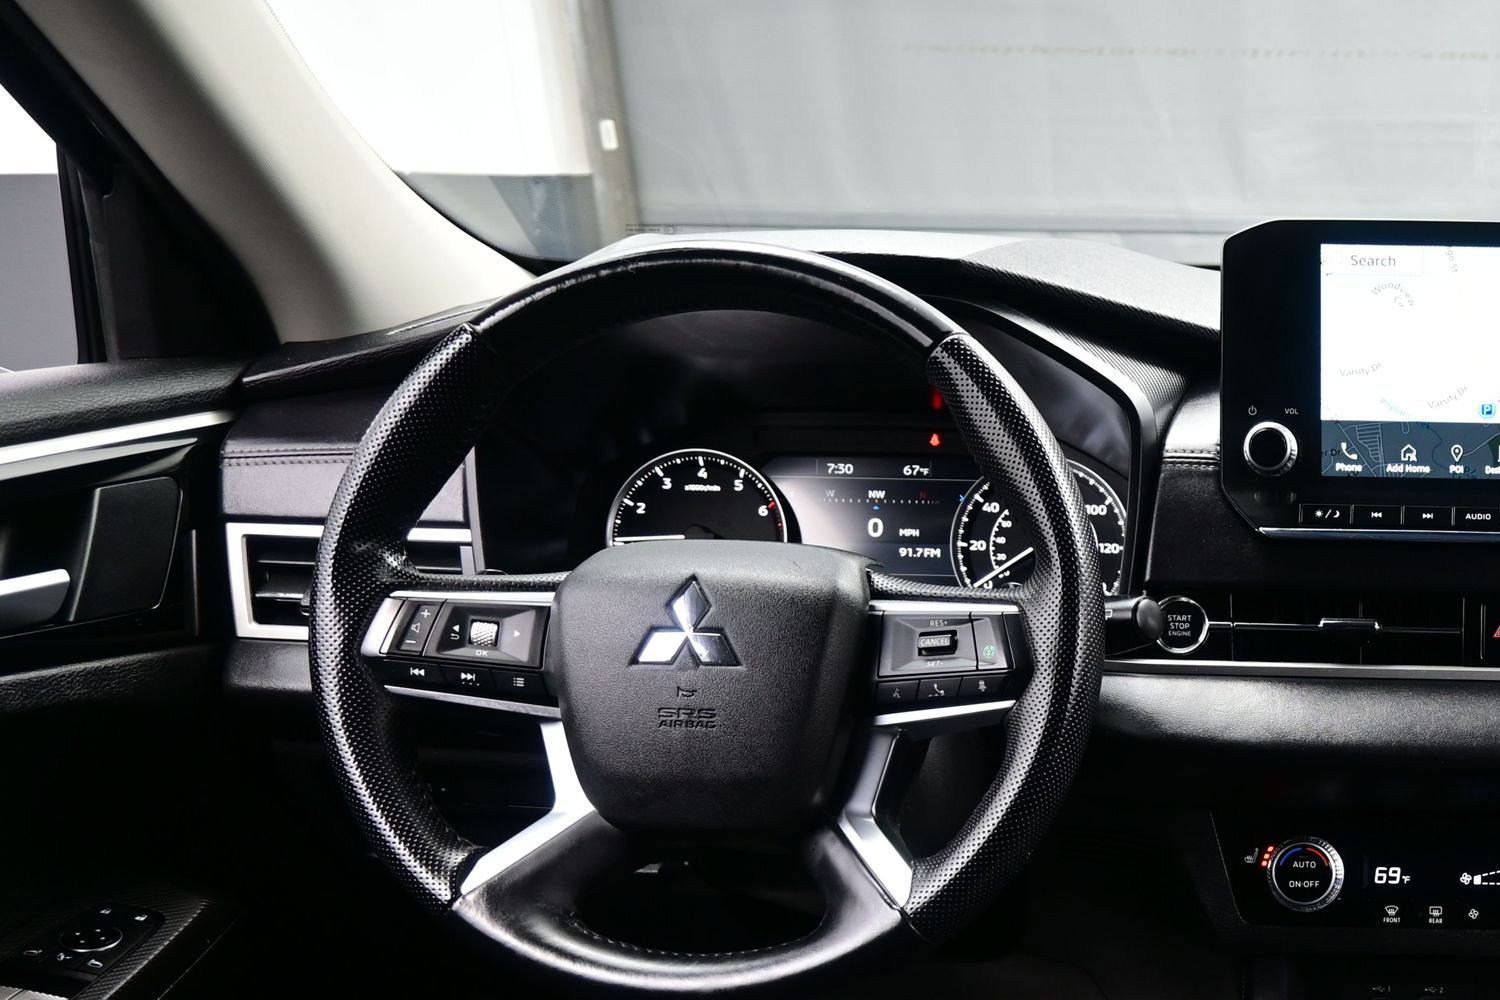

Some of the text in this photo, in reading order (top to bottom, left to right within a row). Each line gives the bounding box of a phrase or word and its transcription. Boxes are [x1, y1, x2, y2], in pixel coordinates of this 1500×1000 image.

[1350, 254, 1396, 267] Search
[1339, 361, 1382, 377] Varsity Dr
[1427, 385, 1468, 409] Varsity Dr
[1284, 407, 1300, 415] VOL
[697, 467, 708, 479] 4
[827, 463, 854, 474] 7:30
[1335, 463, 1363, 472] Phone
[1386, 463, 1431, 474] Add Home
[1449, 465, 1465, 474] POI
[661, 477, 672, 490] 3
[734, 479, 744, 491] 5
[868, 490, 886, 499] NW
[635, 502, 646, 514] 2
[758, 505, 768, 516] 6
[982, 502, 1000, 513] 40
[1465, 513, 1492, 521] AUDIO
[867, 517, 884, 538] 0
[898, 528, 920, 537] MPH
[969, 540, 987, 551] 20
[1098, 543, 1119, 554] 120
[1167, 614, 1192, 622] START
[919, 637, 951, 647] CANCEL
[475, 649, 489, 657] OK
[657, 707, 717, 719] SRS
[657, 719, 717, 729] AIRBAG
[1292, 861, 1317, 869] AUTO
